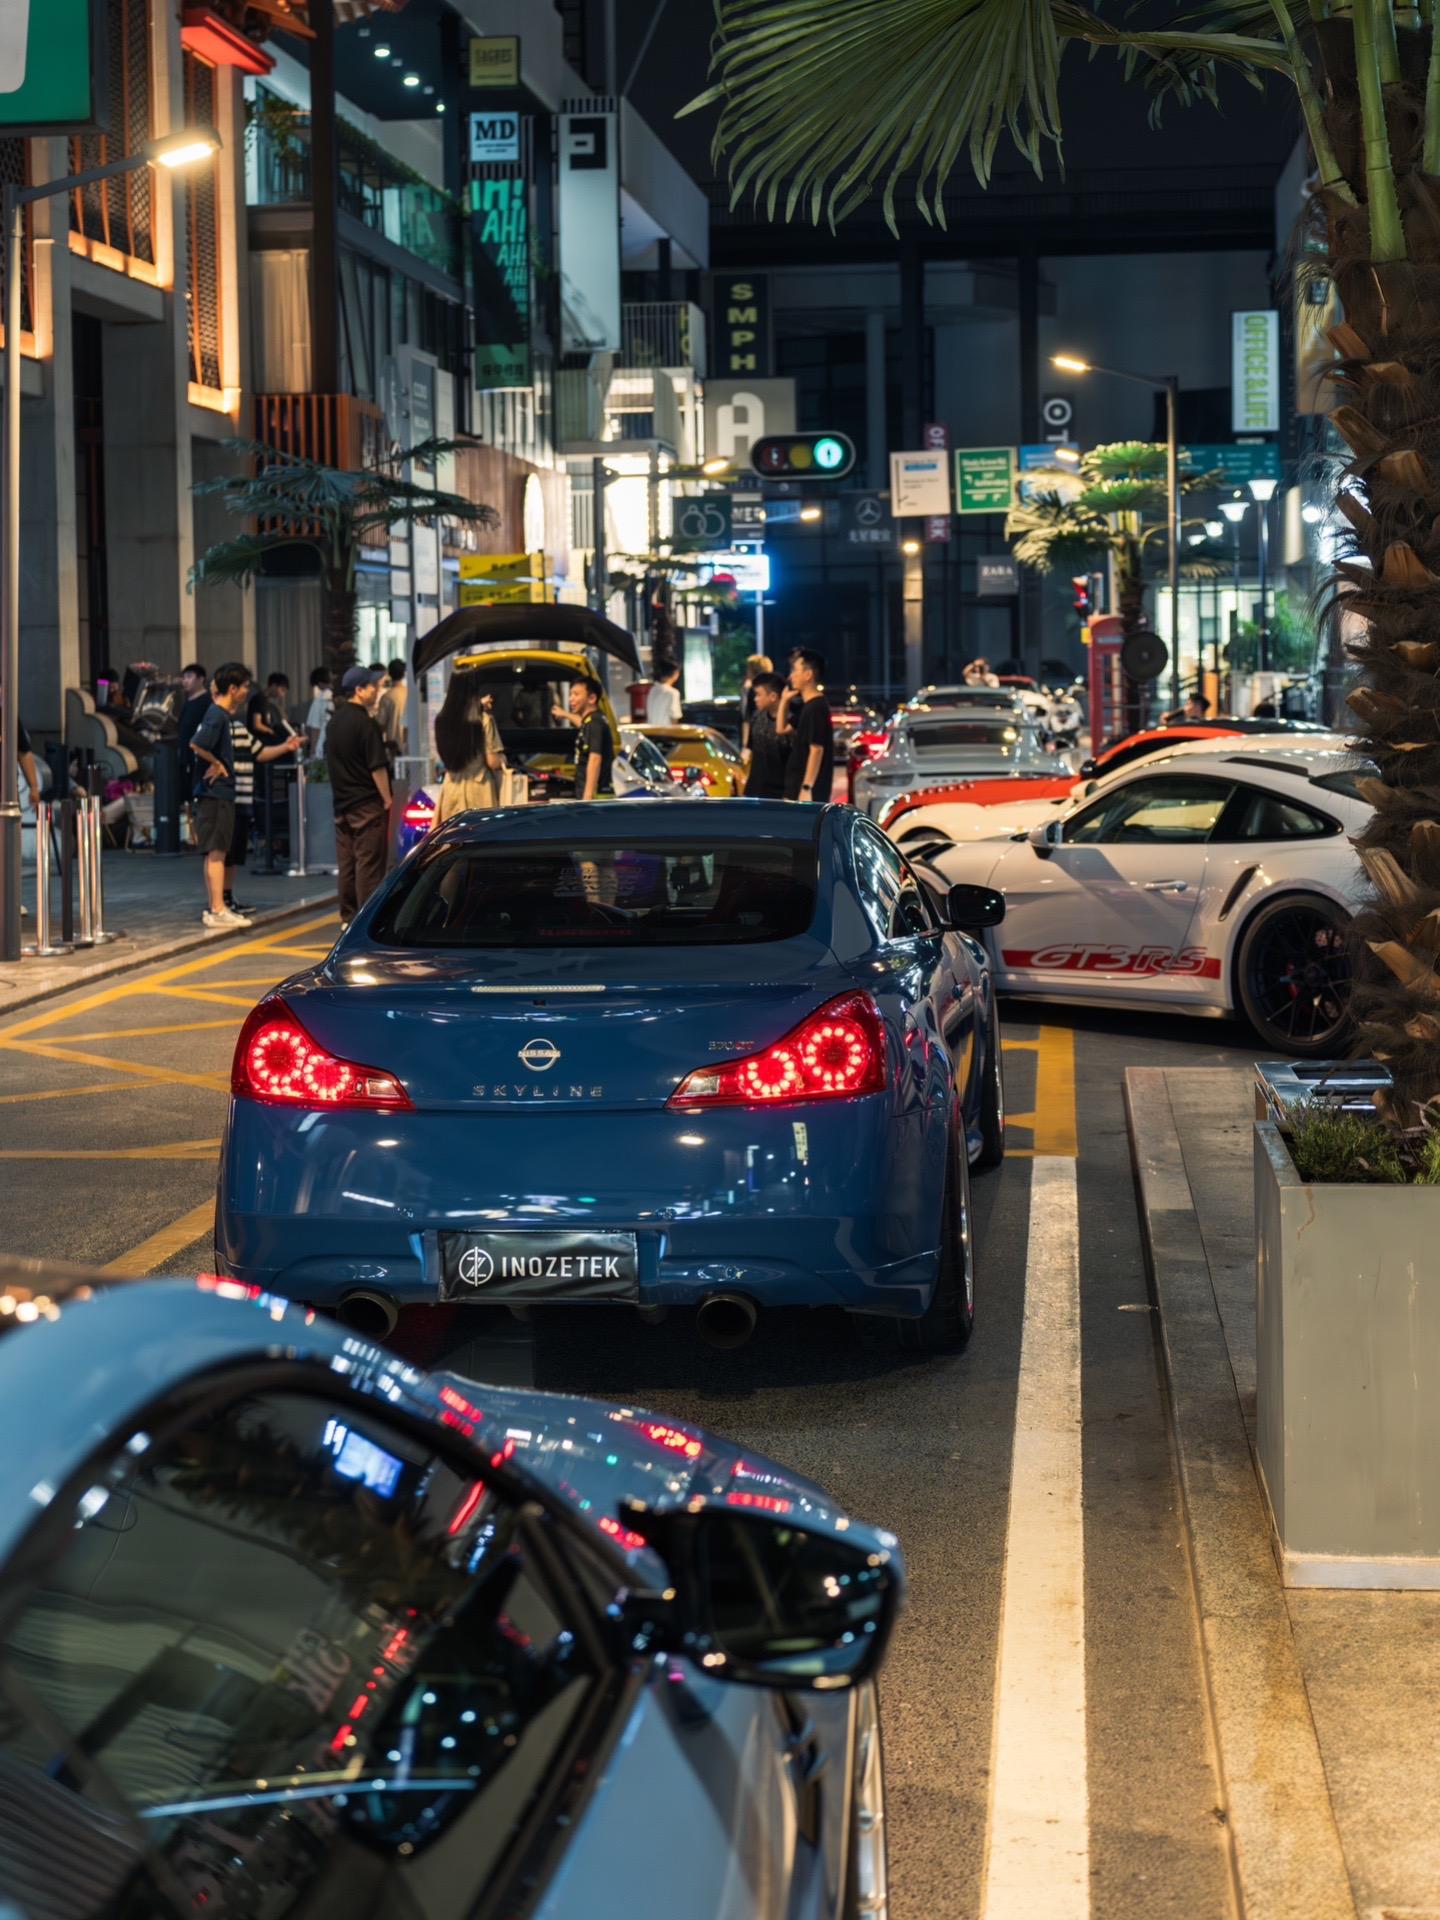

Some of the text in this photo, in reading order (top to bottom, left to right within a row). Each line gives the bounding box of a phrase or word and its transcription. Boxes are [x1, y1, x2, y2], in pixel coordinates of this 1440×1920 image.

[475, 120, 515, 141] MD
[480, 208, 526, 243] AH!
[496, 244, 527, 267] AH!
[472, 1085, 604, 1097] SKYLINE
[501, 1256, 621, 1279] INOZETEK
